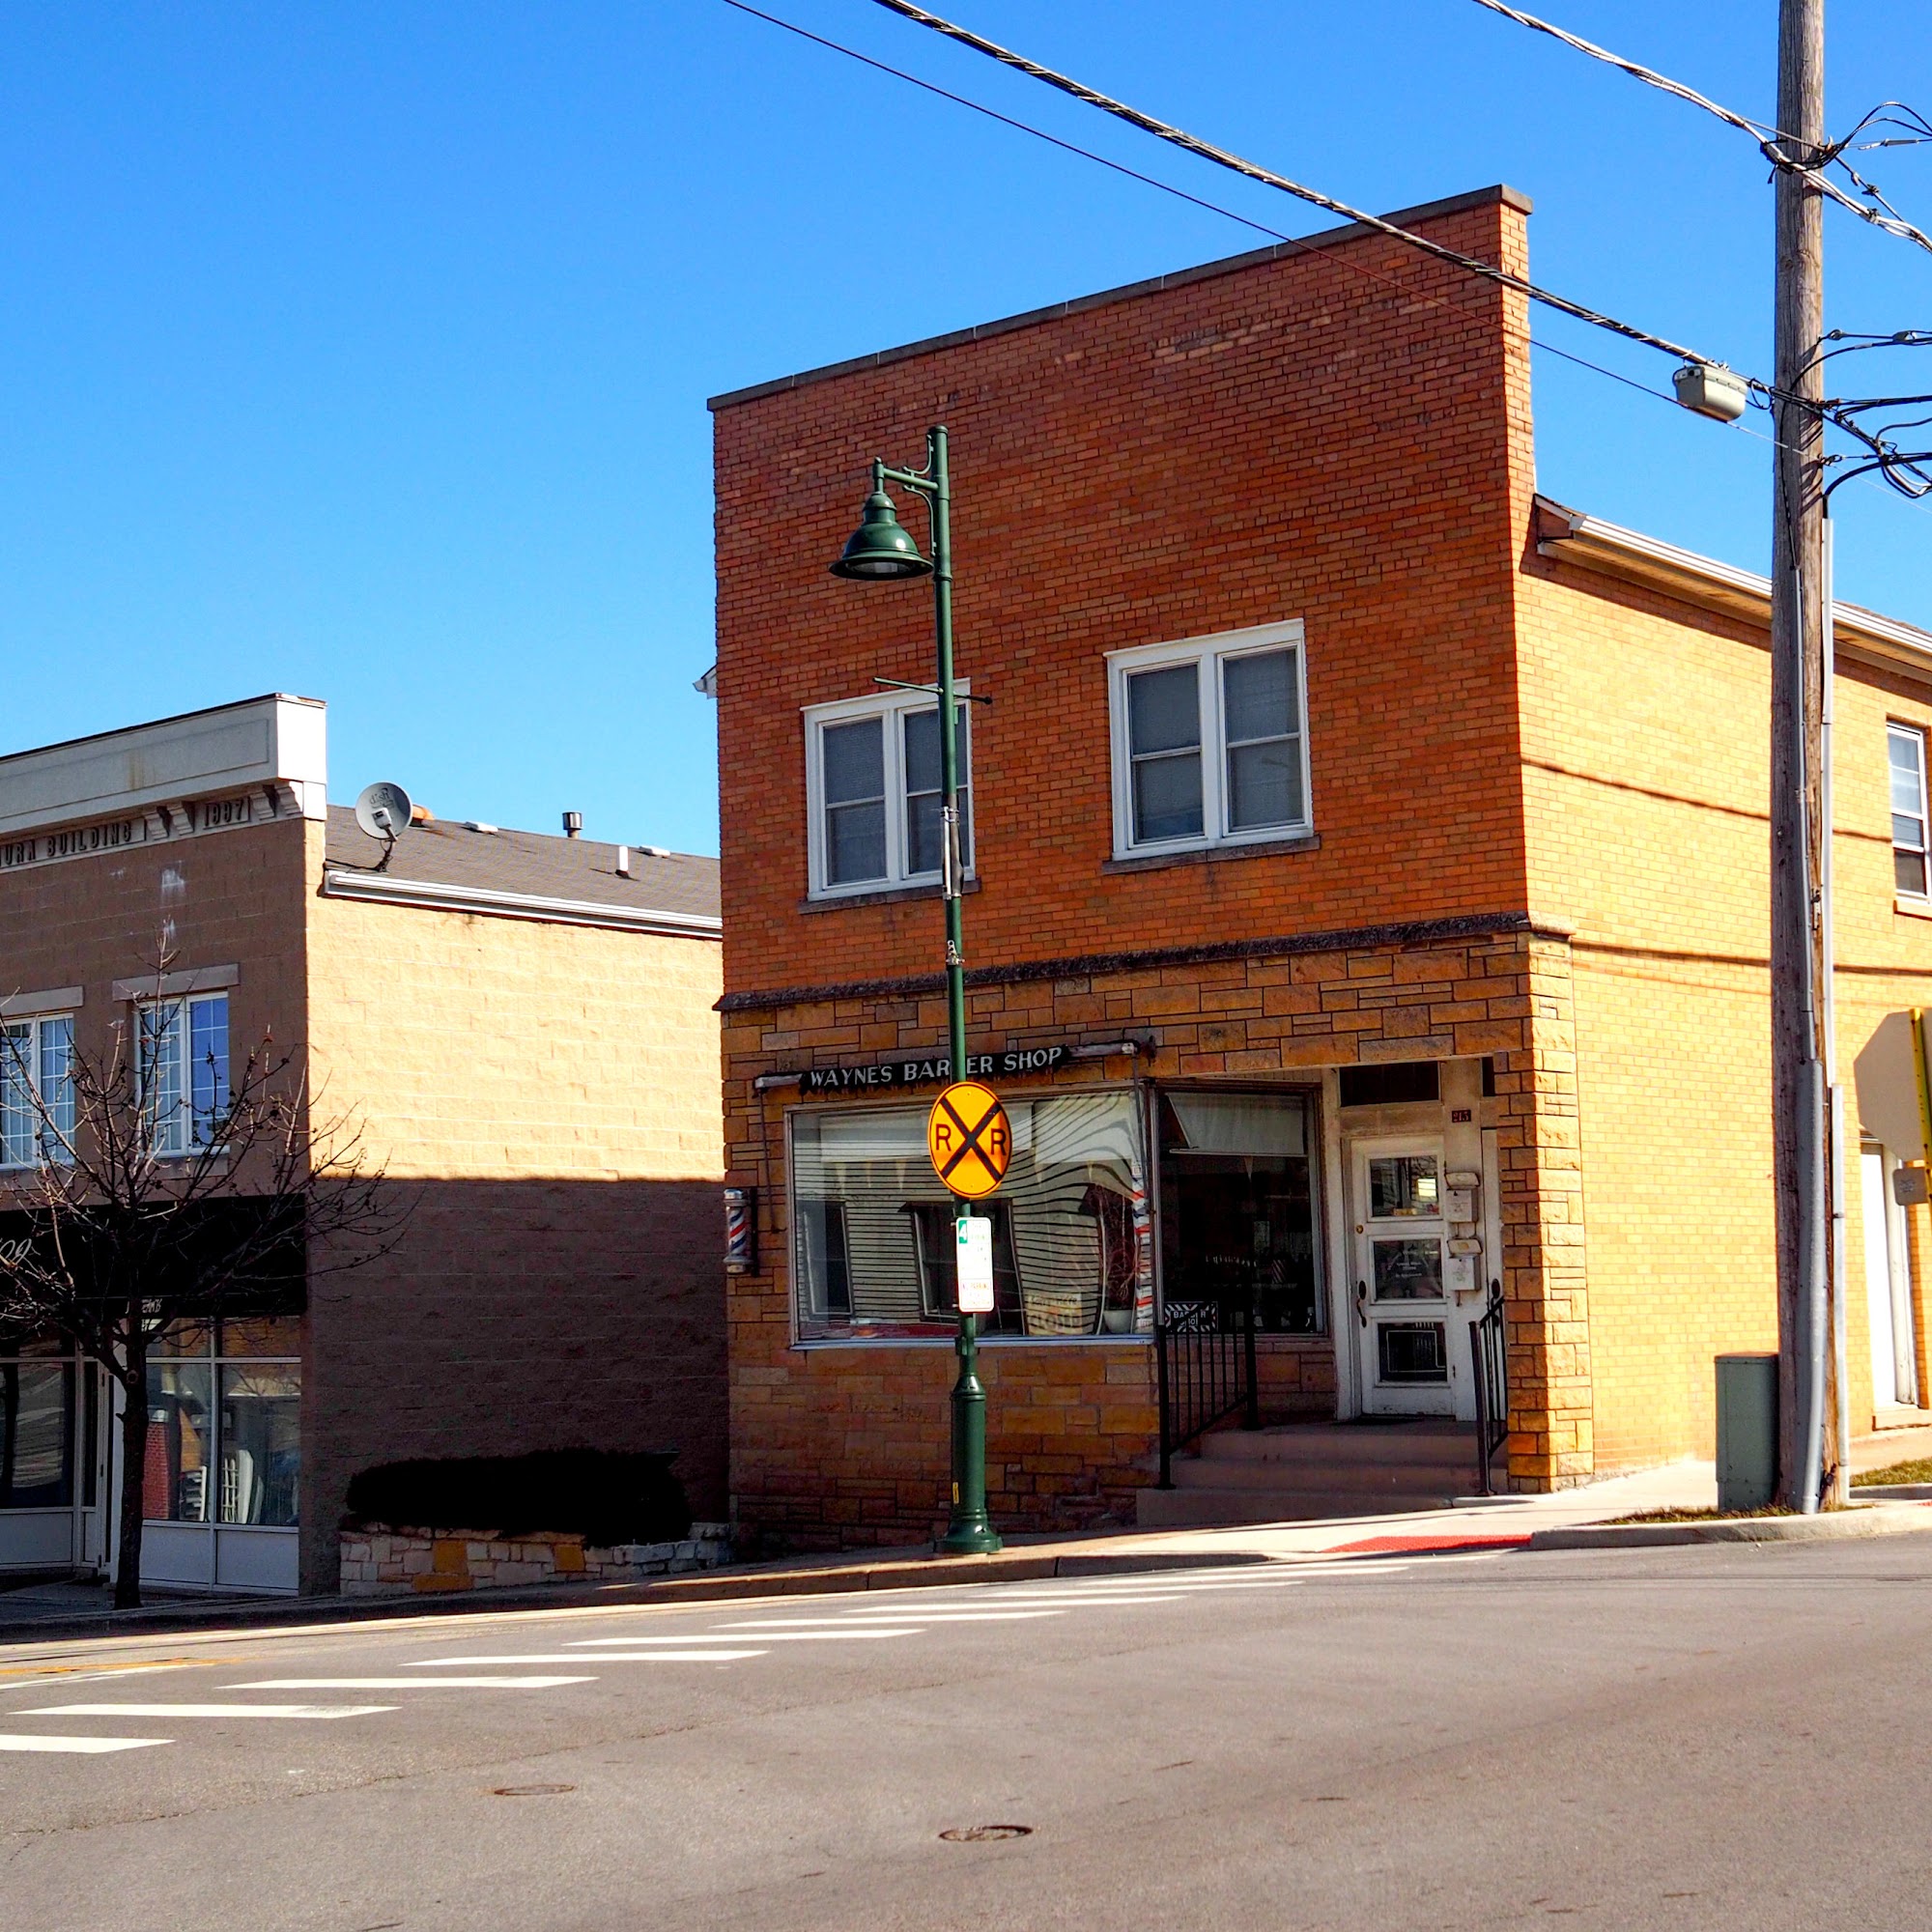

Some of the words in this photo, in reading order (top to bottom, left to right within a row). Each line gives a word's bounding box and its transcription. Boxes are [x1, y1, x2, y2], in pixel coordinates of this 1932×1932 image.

[47, 820, 133, 858] BUILDING
[810, 1065, 894, 1087] WAYNE'S
[903, 1056, 994, 1082] BARER
[1004, 1046, 1063, 1071] SHOP
[935, 1123, 952, 1151] R
[990, 1128, 1007, 1156] R
